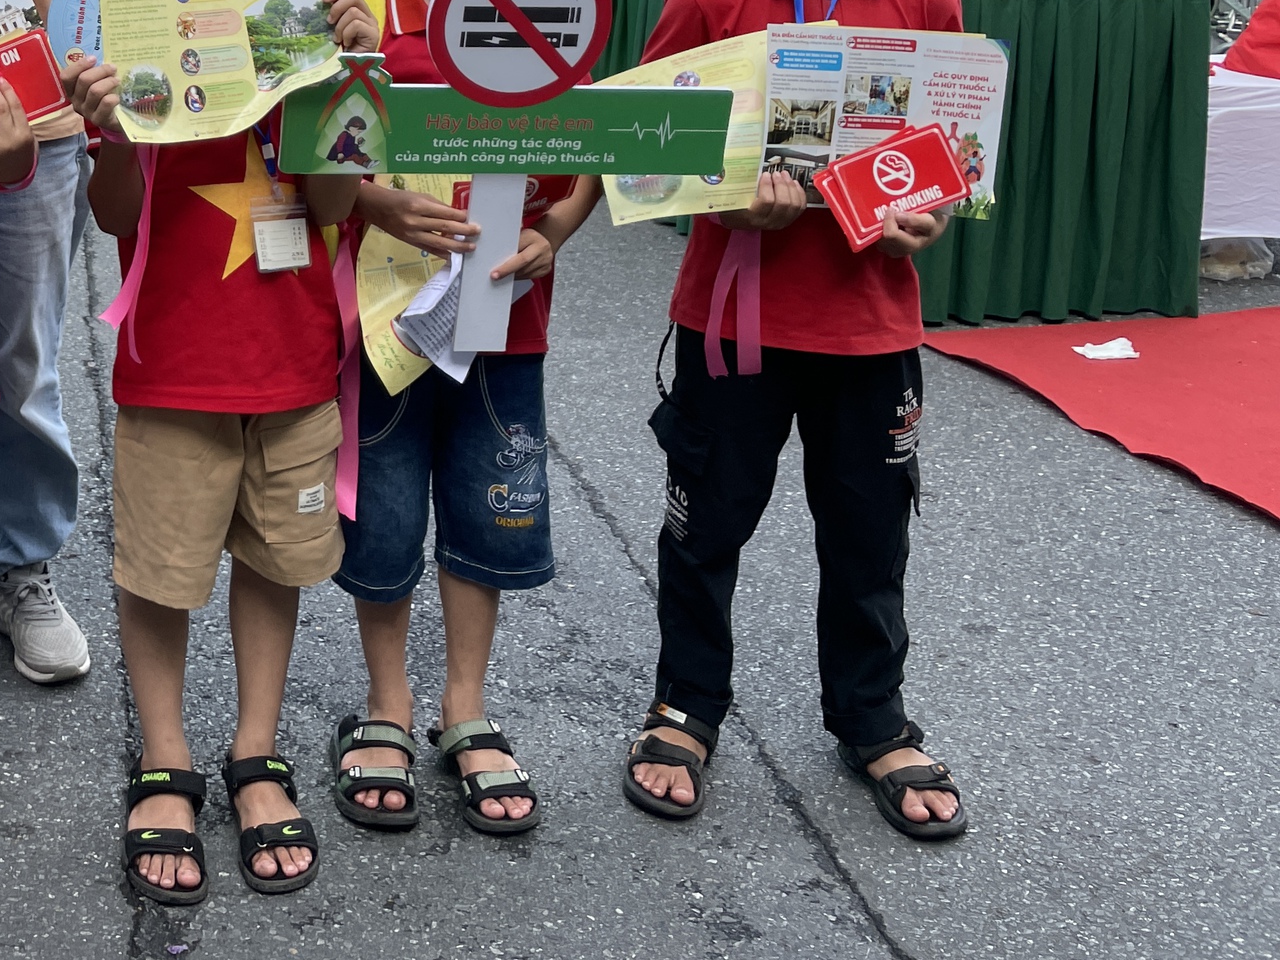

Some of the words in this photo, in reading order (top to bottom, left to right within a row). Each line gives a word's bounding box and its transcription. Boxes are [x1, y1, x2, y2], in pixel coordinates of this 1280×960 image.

[0, 48, 19, 66] NO
[933, 70, 950, 79] CÁC
[969, 75, 989, 83] ĐỊNH
[922, 79, 939, 87] CẤM
[940, 80, 957, 89] HÚT
[959, 82, 986, 91] THUỐC
[987, 85, 997, 93] LÁ
[946, 90, 956, 98] LÝ
[967, 94, 990, 102] PHẠM
[932, 100, 955, 108] HÀNH
[956, 102, 981, 110] CHÍNH
[931, 108, 940, 116] VỀ
[942, 109, 969, 119] THUỐC
[971, 112, 981, 120] LÁ
[426, 113, 463, 134] Hãy
[467, 113, 503, 131] bảo
[507, 114, 530, 133] vệ
[534, 113, 560, 131] trẻ
[564, 118, 594, 131] em
[432, 137, 469, 148] trước
[472, 137, 518, 150] những
[521, 138, 543, 149] tác
[546, 137, 582, 151] động
[395, 151, 420, 162] của
[424, 151, 468, 164] ngành
[471, 152, 505, 164] công
[509, 152, 557, 165] nghiệp
[560, 152, 600, 163] thuốc
[603, 152, 615, 163] lá
[889, 184, 944, 212] SMOKING
